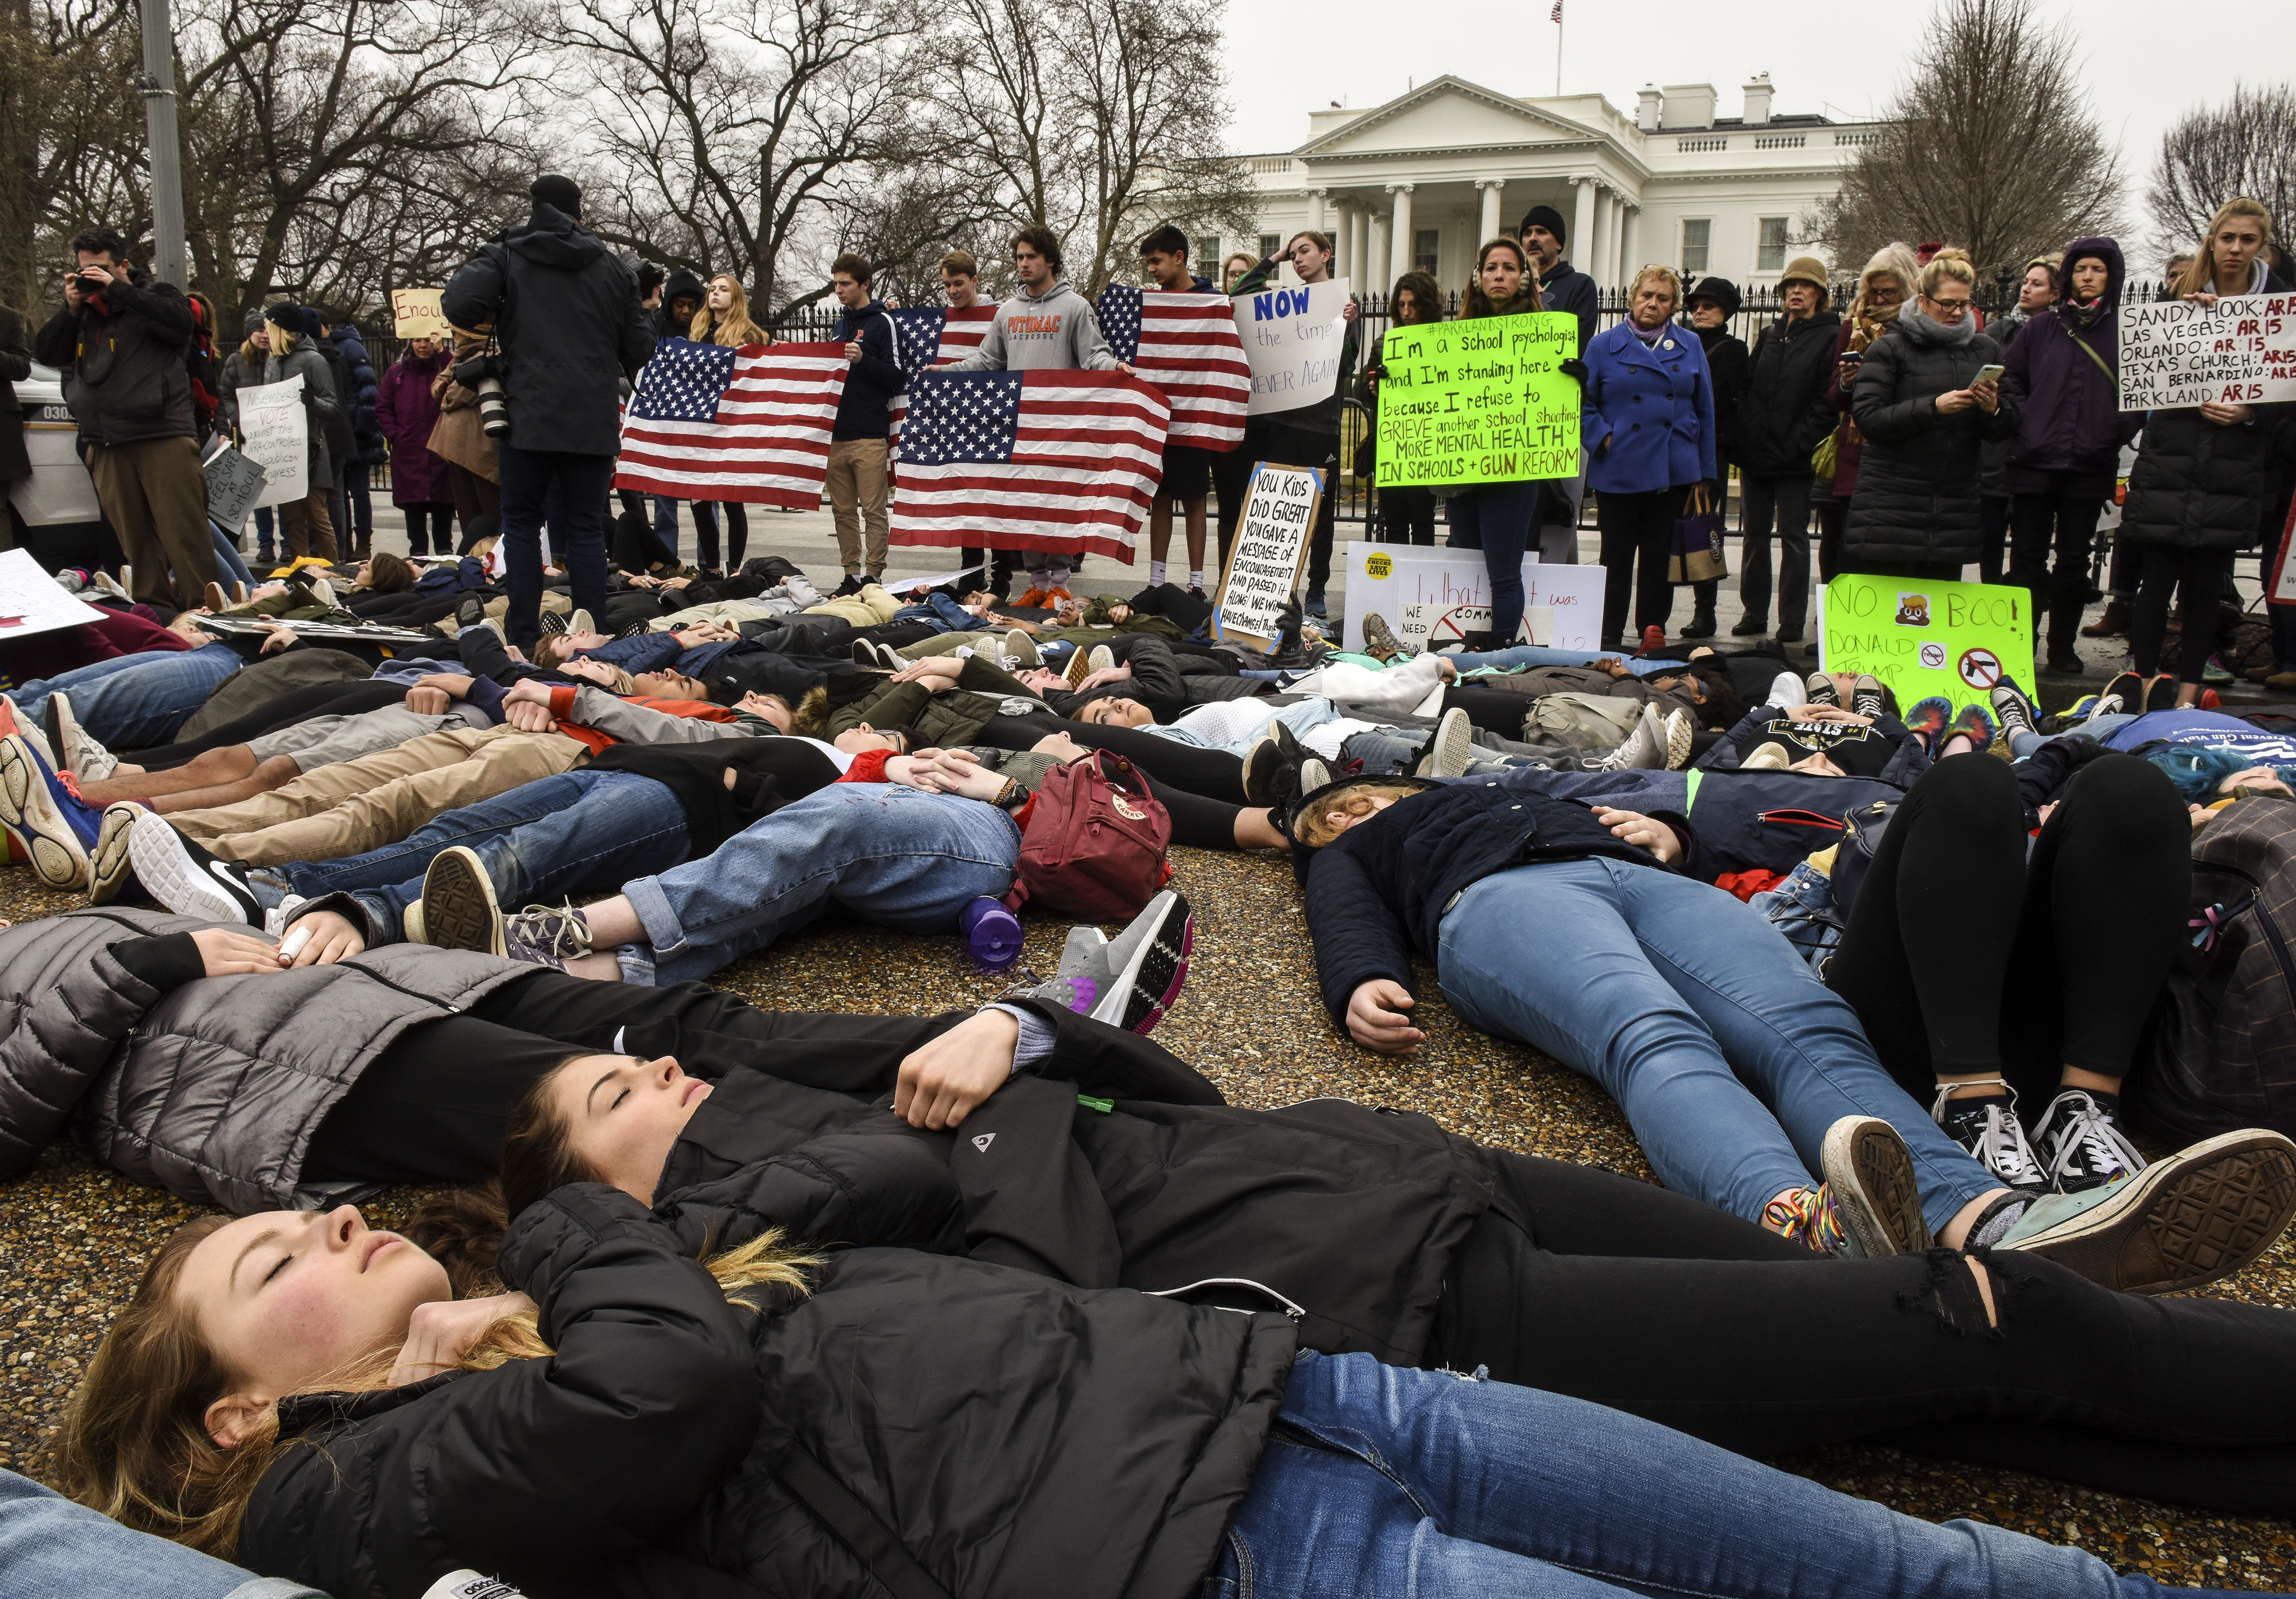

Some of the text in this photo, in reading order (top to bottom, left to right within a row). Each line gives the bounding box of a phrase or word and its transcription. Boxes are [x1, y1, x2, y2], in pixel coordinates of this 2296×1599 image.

[1254, 287, 1309, 321] NOW
[2124, 305, 2196, 328] SANDY
[2205, 300, 2263, 320] HOOK:
[855, 330, 864, 339] P
[1008, 315, 1061, 334] POTOMAC
[1256, 321, 1332, 347] the time
[1426, 313, 1553, 336] #PARKLANDSTRONG
[2122, 329, 2151, 346] LAS
[2236, 319, 2260, 336] AR
[2266, 318, 2282, 336] 15
[1385, 326, 1576, 361] I'm a school psychologist
[2121, 341, 2210, 362] ORLANDO:
[2248, 336, 2266, 351] 15
[1250, 355, 1339, 394] NEVER AGAIN
[1386, 357, 1550, 389] and I'm standing here
[2121, 357, 2179, 377] TEXAS
[2189, 354, 2257, 370] CHURCH:
[2120, 375, 2154, 392] SAN
[2169, 367, 2269, 388] BERNARDINO:
[1384, 383, 1540, 417] because I refuse to
[2123, 384, 2263, 409] PARKLAND: AR 15
[260, 405, 292, 426] VOTE
[1379, 390, 1579, 442] GRIEVE another school shooting!
[247, 425, 293, 440] against the
[1396, 425, 1564, 459] MORE MENTAL HEALTH
[207, 452, 226, 489] DON
[222, 452, 239, 478] SAFE
[263, 466, 296, 486] ongress
[1380, 447, 1578, 482] IN SCHOOLS + GUN REFORM
[209, 481, 228, 506] FEEL
[228, 481, 237, 493] AT
[228, 469, 261, 520] SCHOOL.
[1256, 471, 1279, 494] YOU
[1272, 500, 1310, 524] GREAT.
[1244, 520, 1298, 544] YOU GAVE A
[1238, 542, 1279, 560] MESSAGE
[1229, 573, 1246, 587] AND
[1246, 577, 1277, 594] PASSED
[1226, 590, 1251, 608] ALONG!
[1251, 595, 1265, 610] WE
[1550, 594, 1577, 605] was
[1830, 584, 2018, 632] NO BOO!
[1221, 608, 1238, 625] HAVE
[1406, 606, 1492, 620] WE COMM
[1402, 623, 1427, 634] NEED
[1829, 629, 1915, 656] DONALD
[1832, 657, 1903, 686] TRUMP
[1794, 723, 1844, 735] STATE
[2177, 734, 2210, 742] Viole
